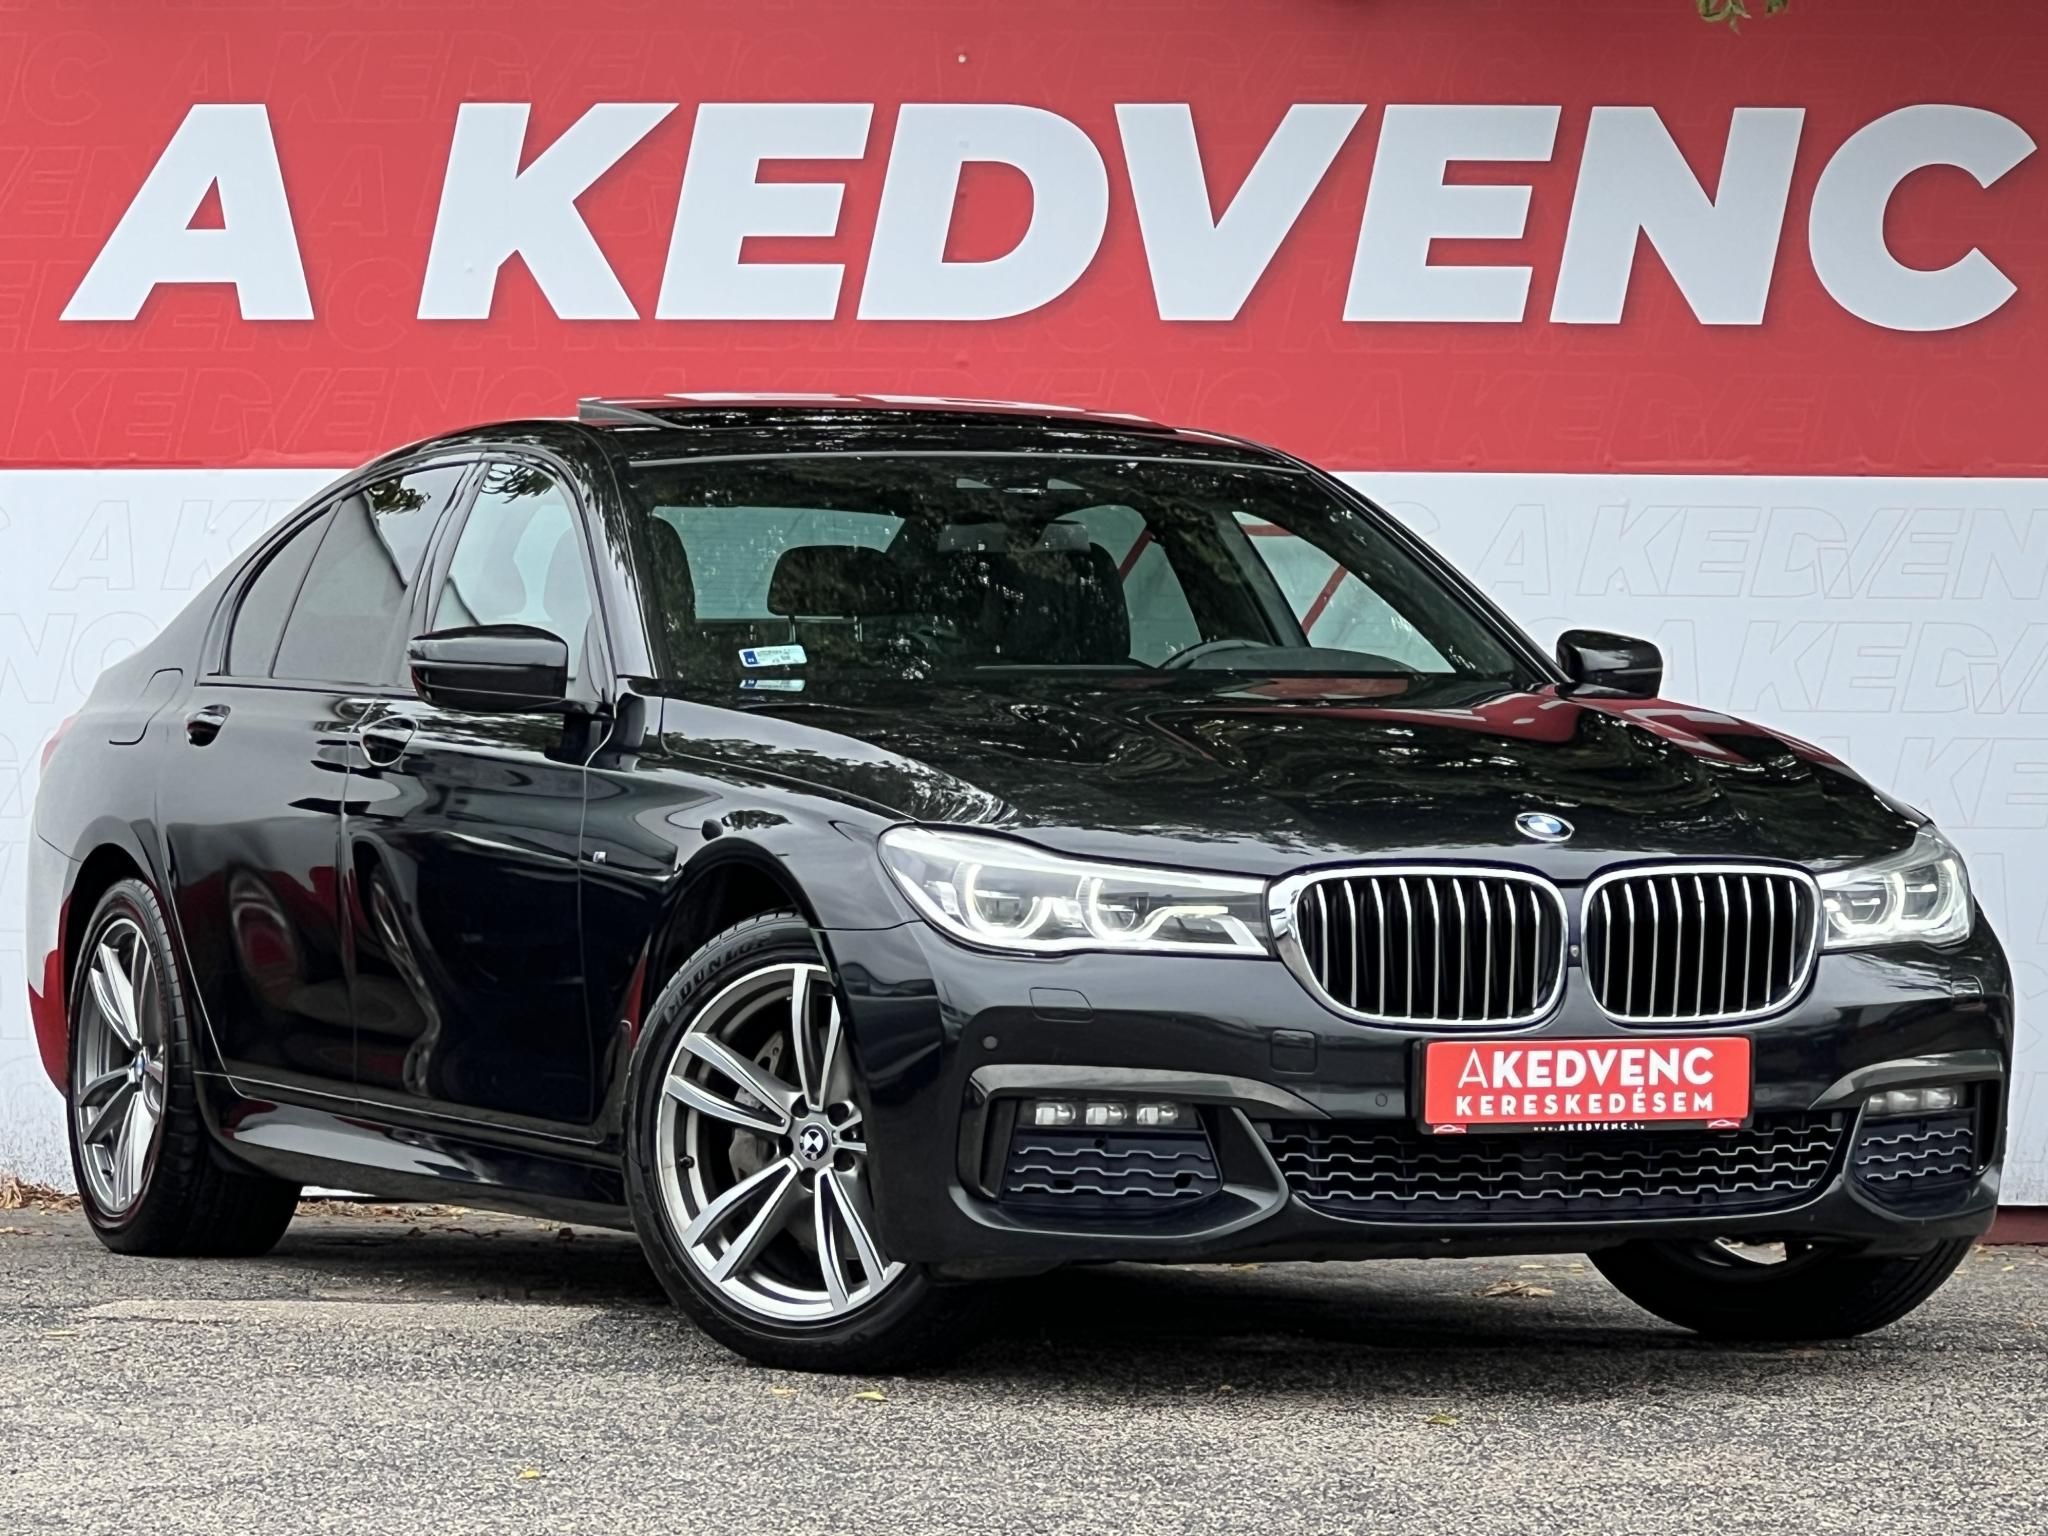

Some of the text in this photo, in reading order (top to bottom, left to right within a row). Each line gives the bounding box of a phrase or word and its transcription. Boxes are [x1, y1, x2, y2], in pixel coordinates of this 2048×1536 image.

[58, 102, 316, 320] A
[416, 102, 2039, 332] KEDVENC
[1456, 1088, 1714, 1117] KERESKEDÉSEM
